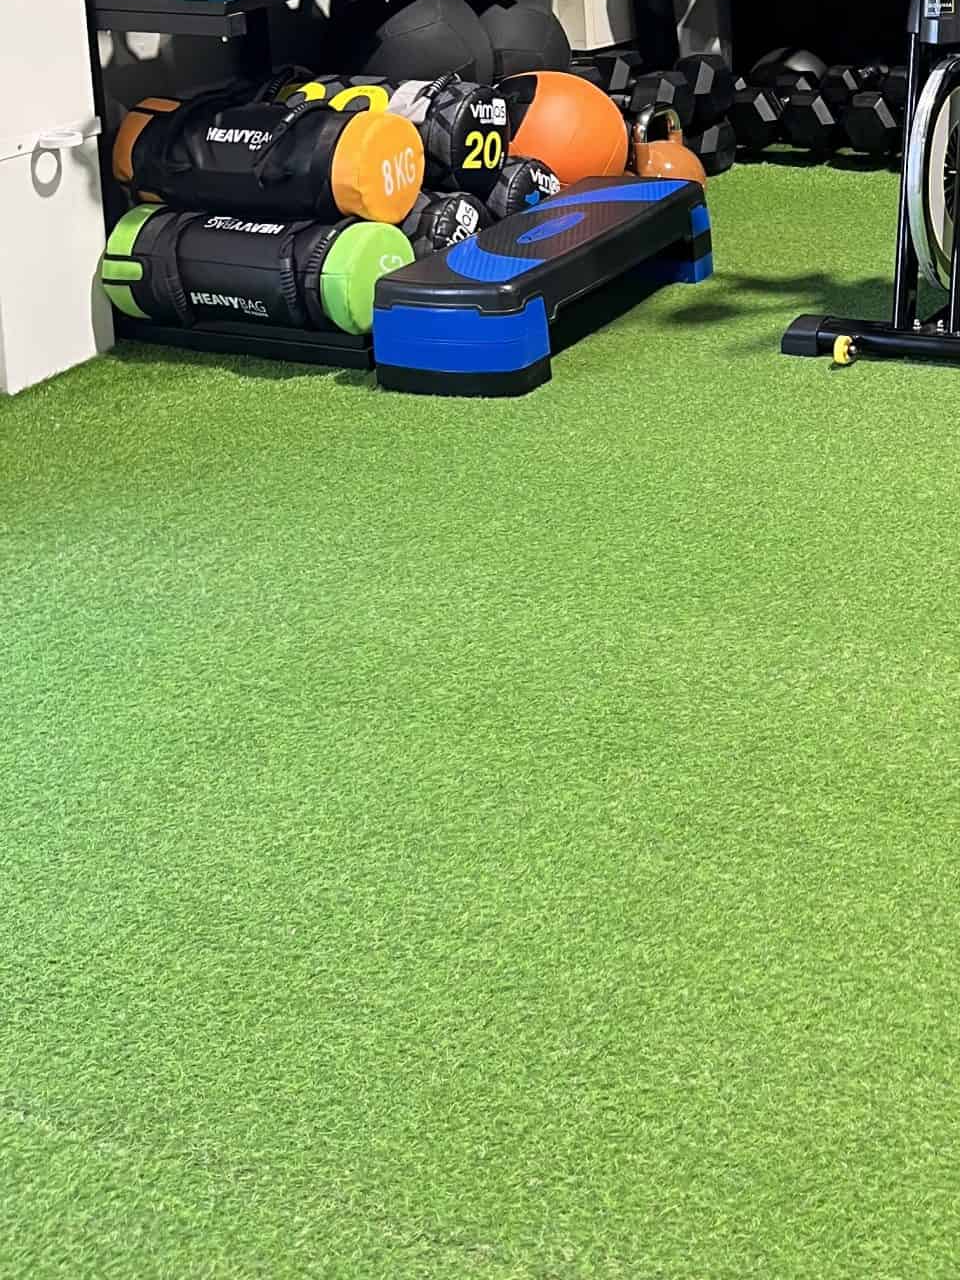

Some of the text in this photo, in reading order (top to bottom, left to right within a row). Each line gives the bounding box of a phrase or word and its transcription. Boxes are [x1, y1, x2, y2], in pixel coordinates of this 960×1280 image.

[206, 127, 272, 143] HEAVYBA
[462, 131, 502, 169] 20
[190, 292, 267, 313] HEAVYBAG
